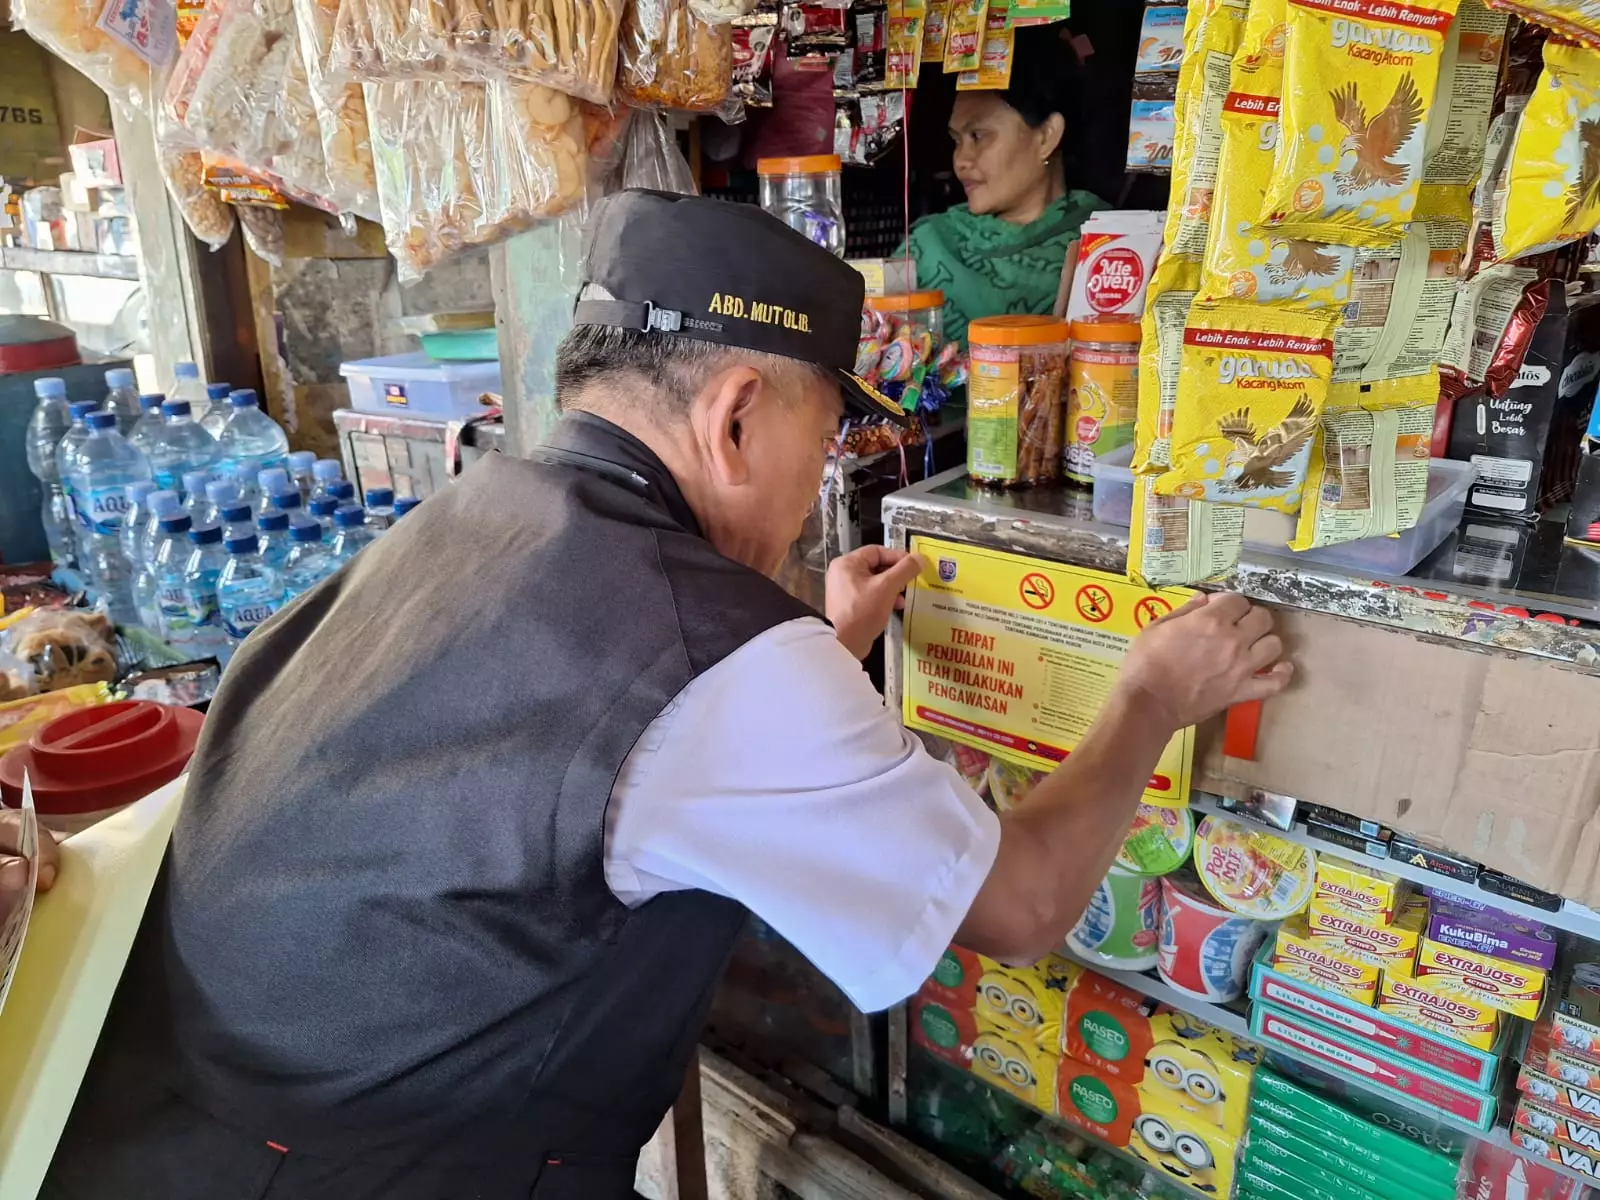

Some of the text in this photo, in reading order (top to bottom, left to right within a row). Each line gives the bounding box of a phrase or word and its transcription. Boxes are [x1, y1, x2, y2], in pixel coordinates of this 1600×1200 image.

[1368, 4, 1397, 19] Lebih
[1234, 98, 1265, 111] Lebih
[1100, 258, 1132, 276] Mie
[1090, 274, 1138, 293] Oven
[1195, 332, 1222, 344] Lebih
[1224, 334, 1250, 346] Enak
[1257, 337, 1284, 349] Lebih
[1491, 421, 1527, 436] Besar
[233, 605, 274, 622] AQUA
[951, 627, 996, 651] TEMPAT
[927, 642, 1014, 677] PENJUALAN INI
[917, 659, 1024, 699] TELAH DILAKUKAN
[928, 680, 1008, 715] PENGAWASAN
[1206, 846, 1226, 879] POP
[1440, 924, 1509, 950] KukuBima
[1434, 950, 1528, 988] EXTRAJOSS
[1274, 989, 1353, 1025] LILIN LAMPU
[1275, 1026, 1353, 1063] LILIN LAMPU
